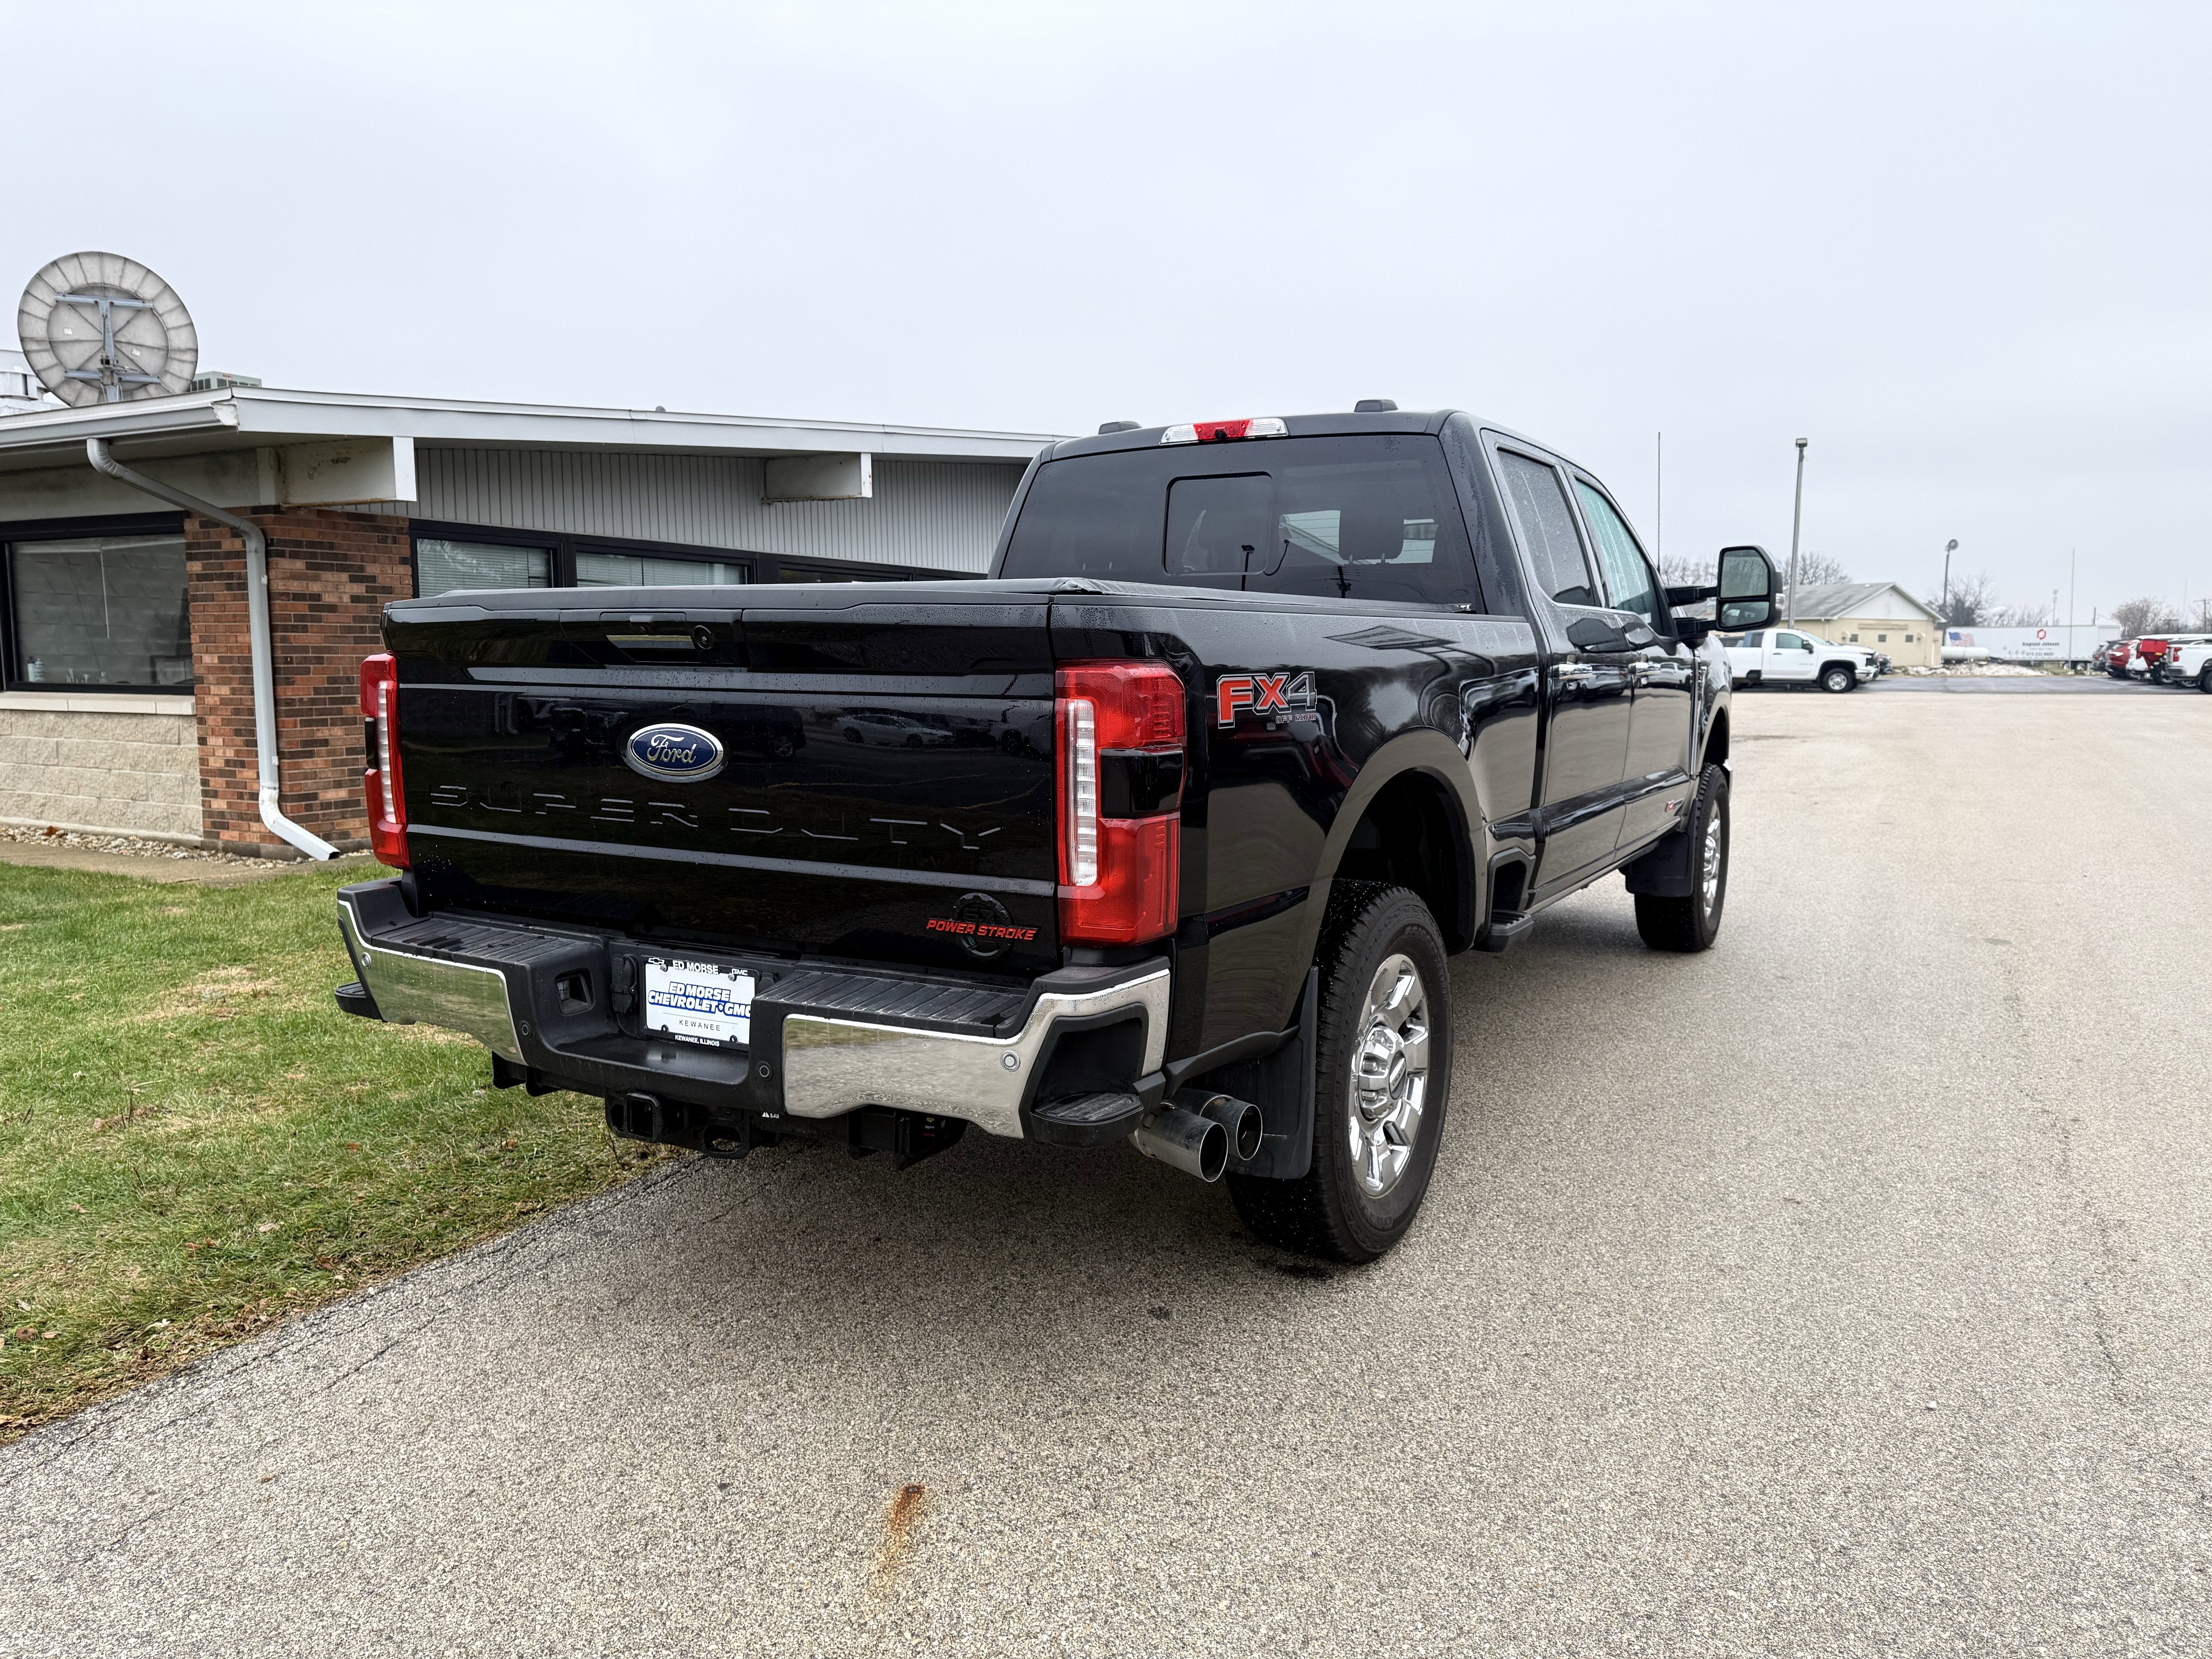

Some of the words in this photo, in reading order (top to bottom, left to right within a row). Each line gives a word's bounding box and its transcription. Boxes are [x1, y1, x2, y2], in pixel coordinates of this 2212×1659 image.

[1216, 671, 1317, 729] FX4
[1276, 714, 1293, 724] OFF
[1295, 713, 1317, 722] ROAD
[647, 734, 697, 764] Ford
[429, 785, 699, 828] SUPER
[728, 807, 1002, 850] DUTY
[926, 919, 976, 934] POWER
[977, 925, 1037, 940] STROKE
[672, 960, 685, 970] ED
[686, 962, 719, 975] MORSE
[669, 982, 686, 994] ED
[685, 984, 731, 1002] MORSE
[679, 1019, 720, 1031] KEWANEE
[675, 1034, 699, 1044] KEWANEE,
[700, 1039, 720, 1047] ILLINOIS
